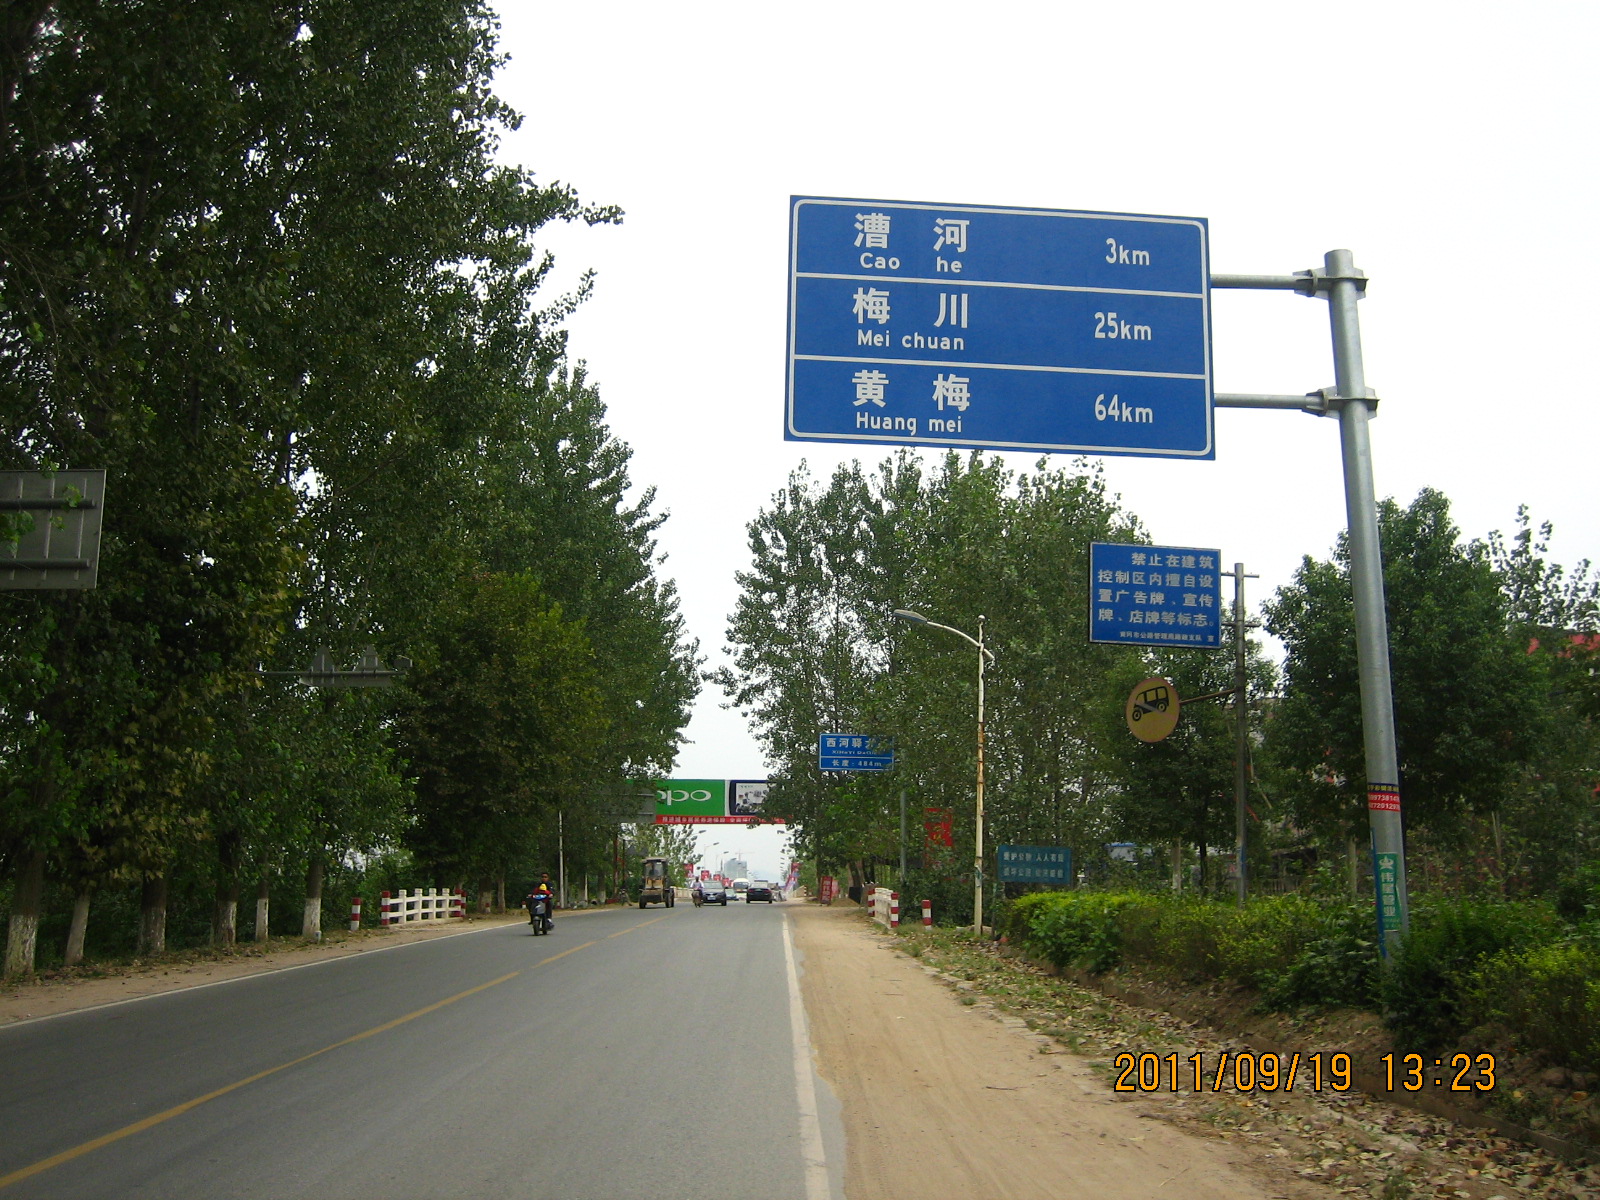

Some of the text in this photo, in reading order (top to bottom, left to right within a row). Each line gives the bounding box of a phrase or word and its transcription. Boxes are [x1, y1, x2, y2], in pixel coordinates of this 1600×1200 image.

[853, 212, 970, 253] 漕河
[859, 252, 963, 274] Cao he
[1105, 237, 1151, 267] 3km
[852, 286, 970, 329] 梅川
[857, 330, 965, 351] Mei chuan
[1093, 311, 1153, 342] 25km
[851, 369, 971, 412] 黄梅
[1094, 393, 1154, 425] 64km
[856, 411, 963, 437] Huang mei
[1131, 552, 1214, 569] 禁止在建筑
[1098, 569, 1213, 588] 控制区内擅自设
[1098, 588, 1213, 607] 置广告牌、宣传
